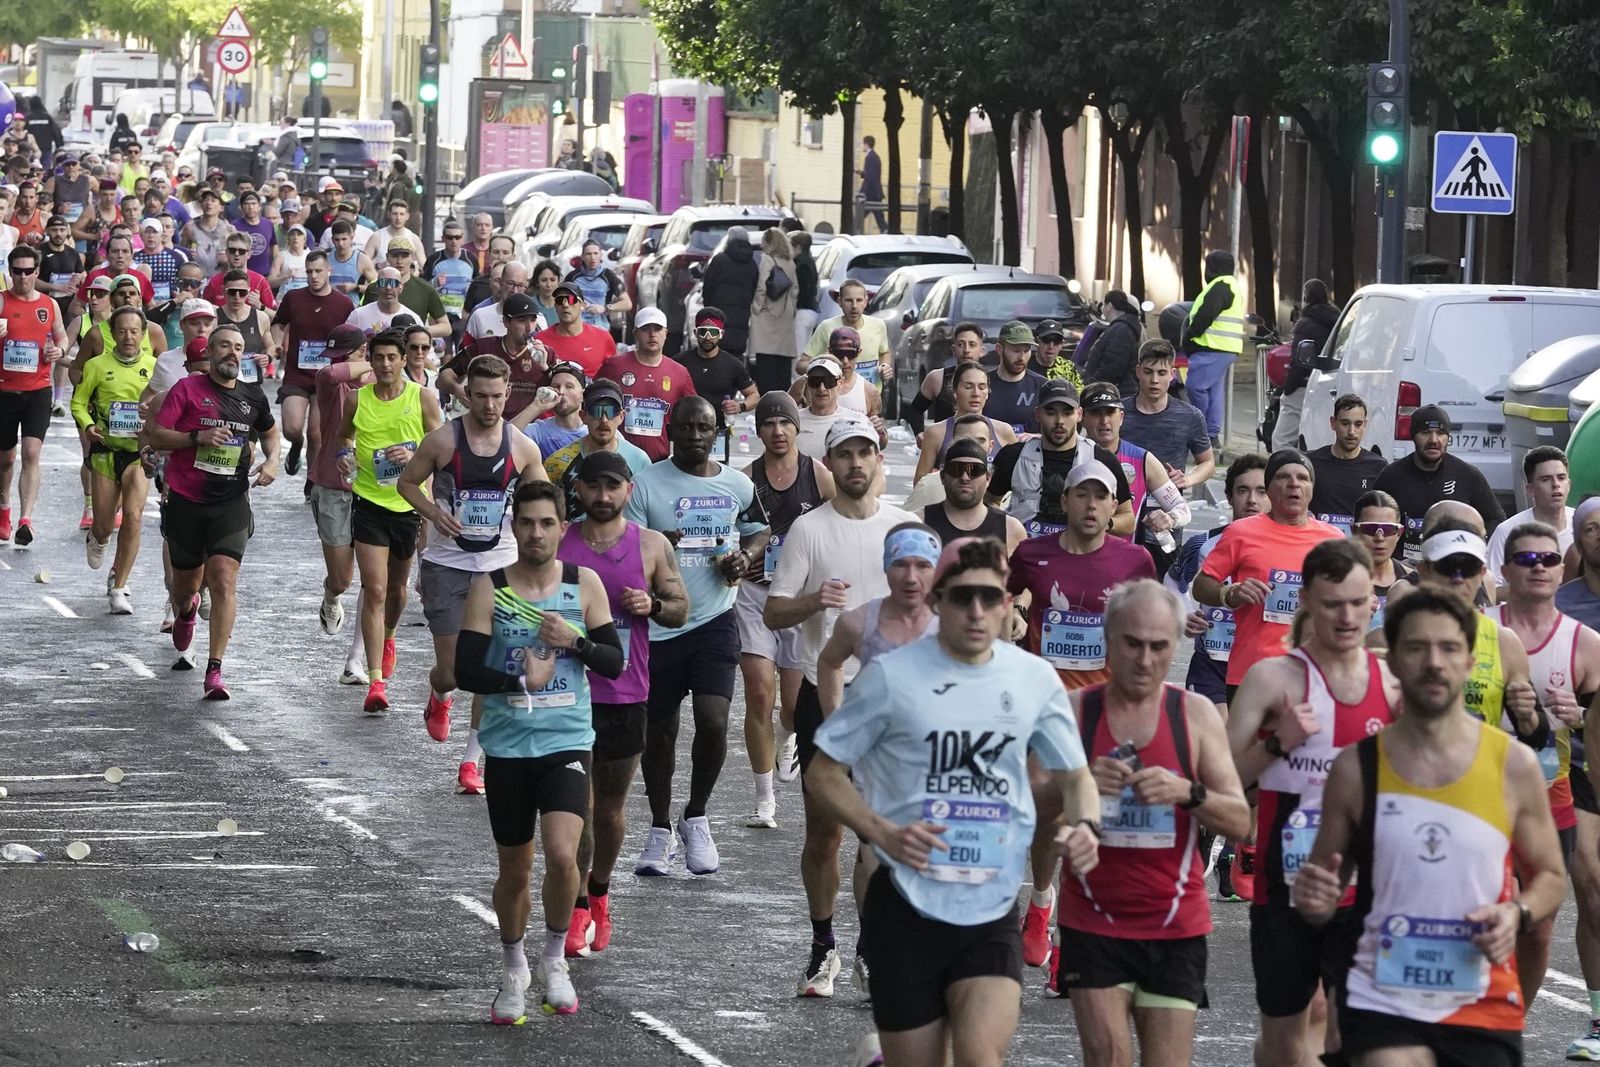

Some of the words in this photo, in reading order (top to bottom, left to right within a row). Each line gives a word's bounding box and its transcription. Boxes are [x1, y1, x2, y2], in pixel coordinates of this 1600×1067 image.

[224, 50, 246, 64] 30
[9, 357, 32, 365] HARRY
[638, 400, 662, 409] ZURICH
[1482, 436, 1507, 448] MFY
[207, 454, 232, 466] JORGE
[472, 492, 500, 500] ZURICH
[694, 499, 725, 507] ZURICH
[468, 514, 490, 525] WILL
[696, 514, 712, 522] 7385
[715, 525, 730, 535] DJO
[1065, 614, 1101, 624] ZURICH
[1065, 632, 1084, 641] 6086
[1046, 642, 1102, 656] ROBERTO
[1205, 640, 1221, 649] EDU
[954, 805, 1001, 818] ZURICH
[949, 846, 981, 863] EDU
[1415, 922, 1473, 938] ZURICH
[1403, 965, 1455, 986] FELIX
